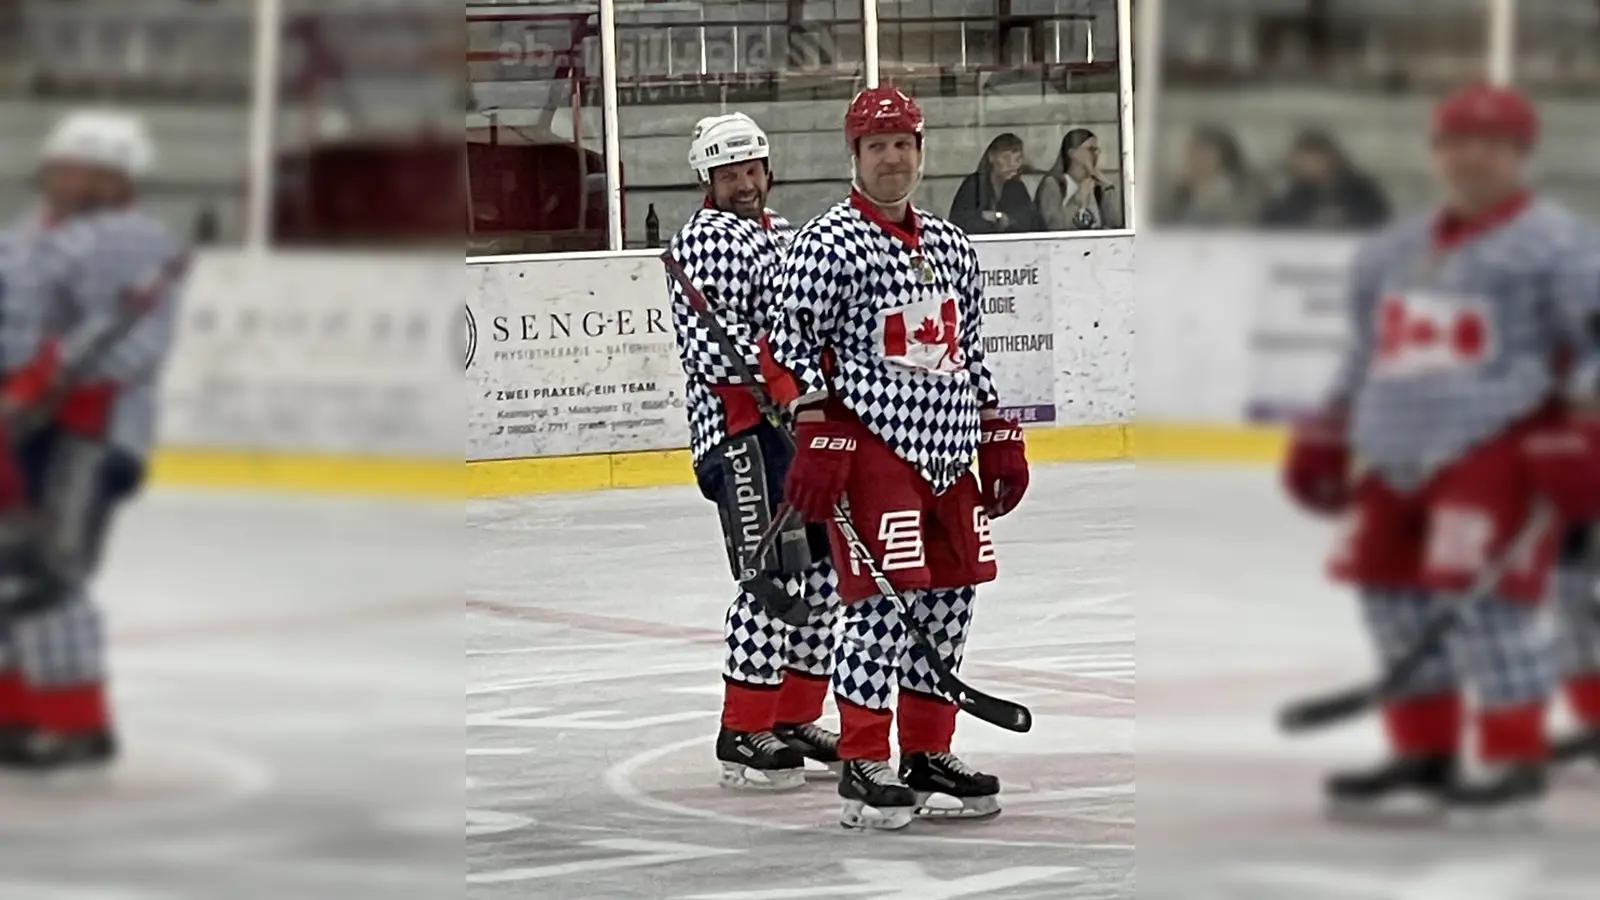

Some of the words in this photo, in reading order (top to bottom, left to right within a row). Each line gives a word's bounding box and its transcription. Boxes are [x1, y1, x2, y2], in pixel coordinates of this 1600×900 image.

[493, 308, 669, 342] SENGER
[496, 390, 529, 401] ZWEI
[594, 383, 616, 395] EIN
